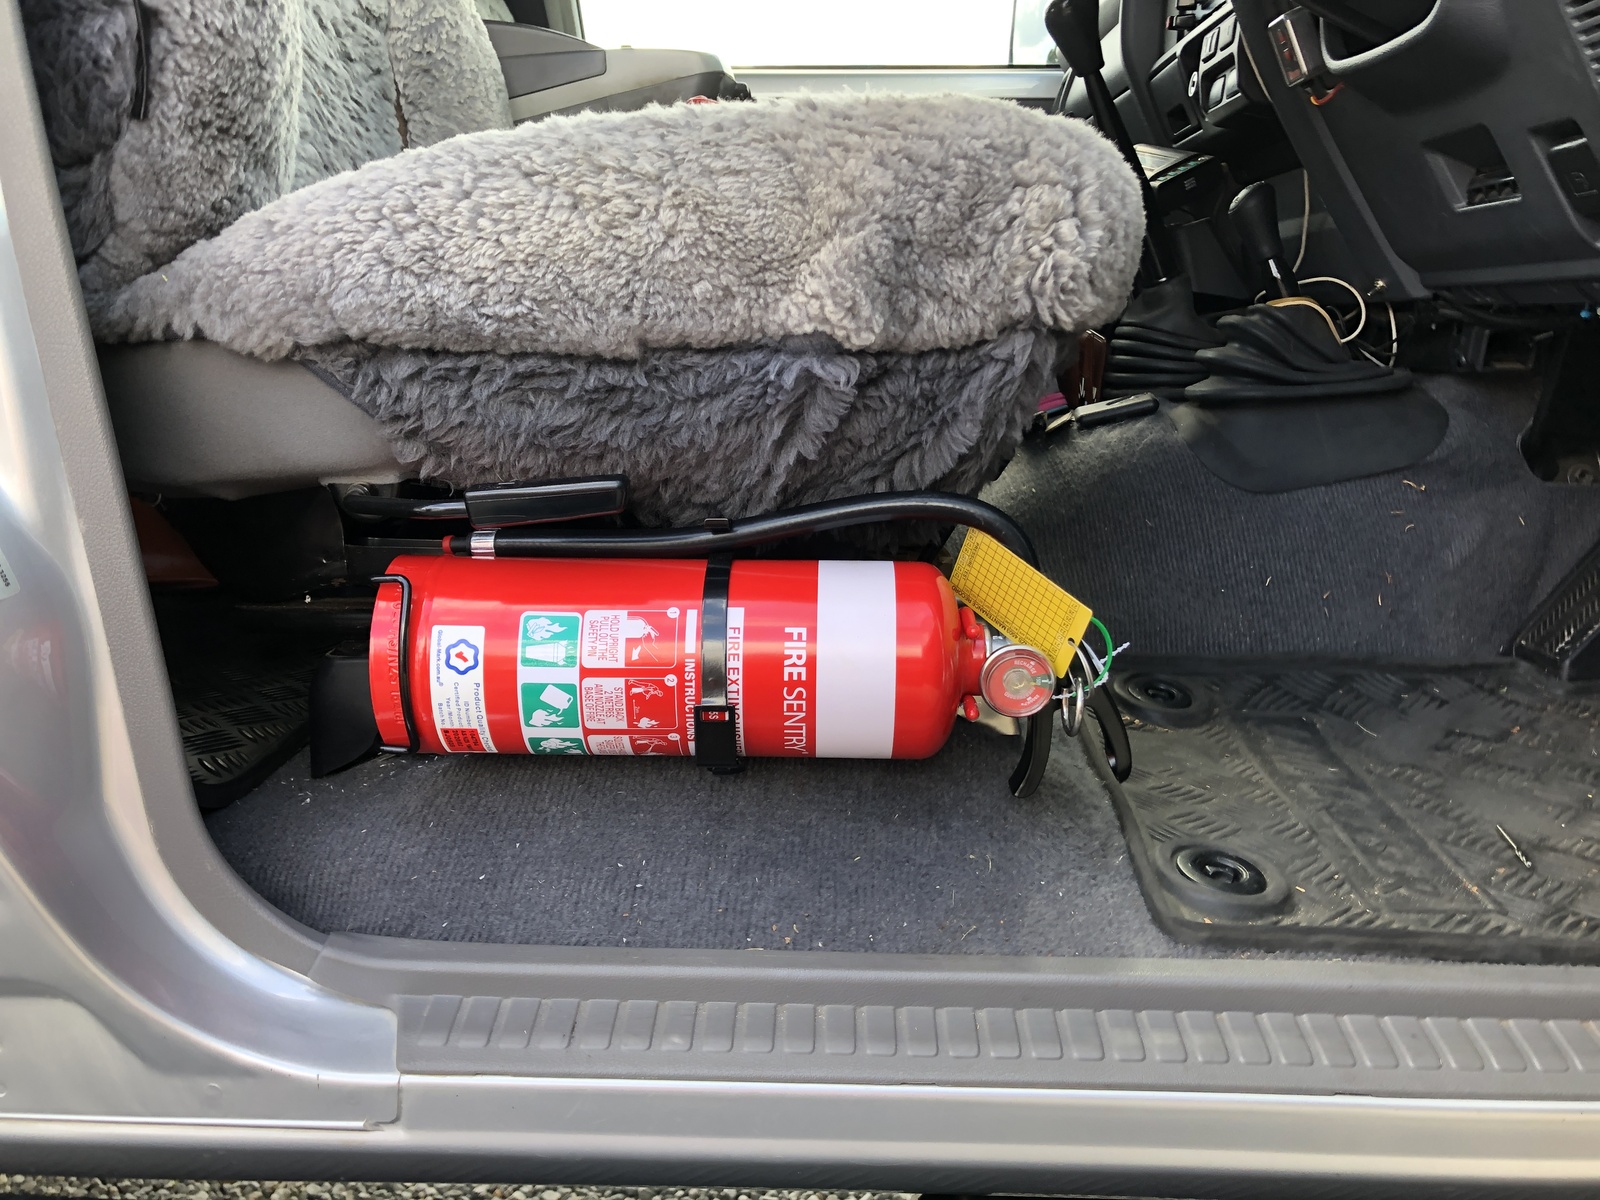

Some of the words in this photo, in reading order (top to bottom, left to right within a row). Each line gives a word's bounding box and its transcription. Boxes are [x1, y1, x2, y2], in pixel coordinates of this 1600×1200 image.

[952, 586, 972, 604] RECORD
[599, 616, 610, 632] PULL
[610, 615, 620, 632] HOLD
[972, 601, 1007, 630] MAINTENANCE
[588, 620, 599, 645] SAFETY
[599, 632, 608, 646] OUT
[587, 646, 597, 657] PIN
[598, 646, 608, 661] THE
[609, 632, 619, 662] UPRIGHT
[728, 627, 740, 662] FIRE
[783, 627, 807, 681] FIRE
[584, 687, 594, 702] BASE
[594, 684, 603, 696] AIM
[614, 687, 623, 708] STAND
[685, 659, 695, 740] INSTRUCTIONS
[585, 703, 594, 711] OF
[595, 696, 605, 717] NOZZLE
[605, 696, 614, 718] METRES
[615, 709, 624, 722] BACK
[477, 714, 485, 734] Quality
[586, 711, 596, 722] FIRE
[783, 687, 807, 752] SENTRY
